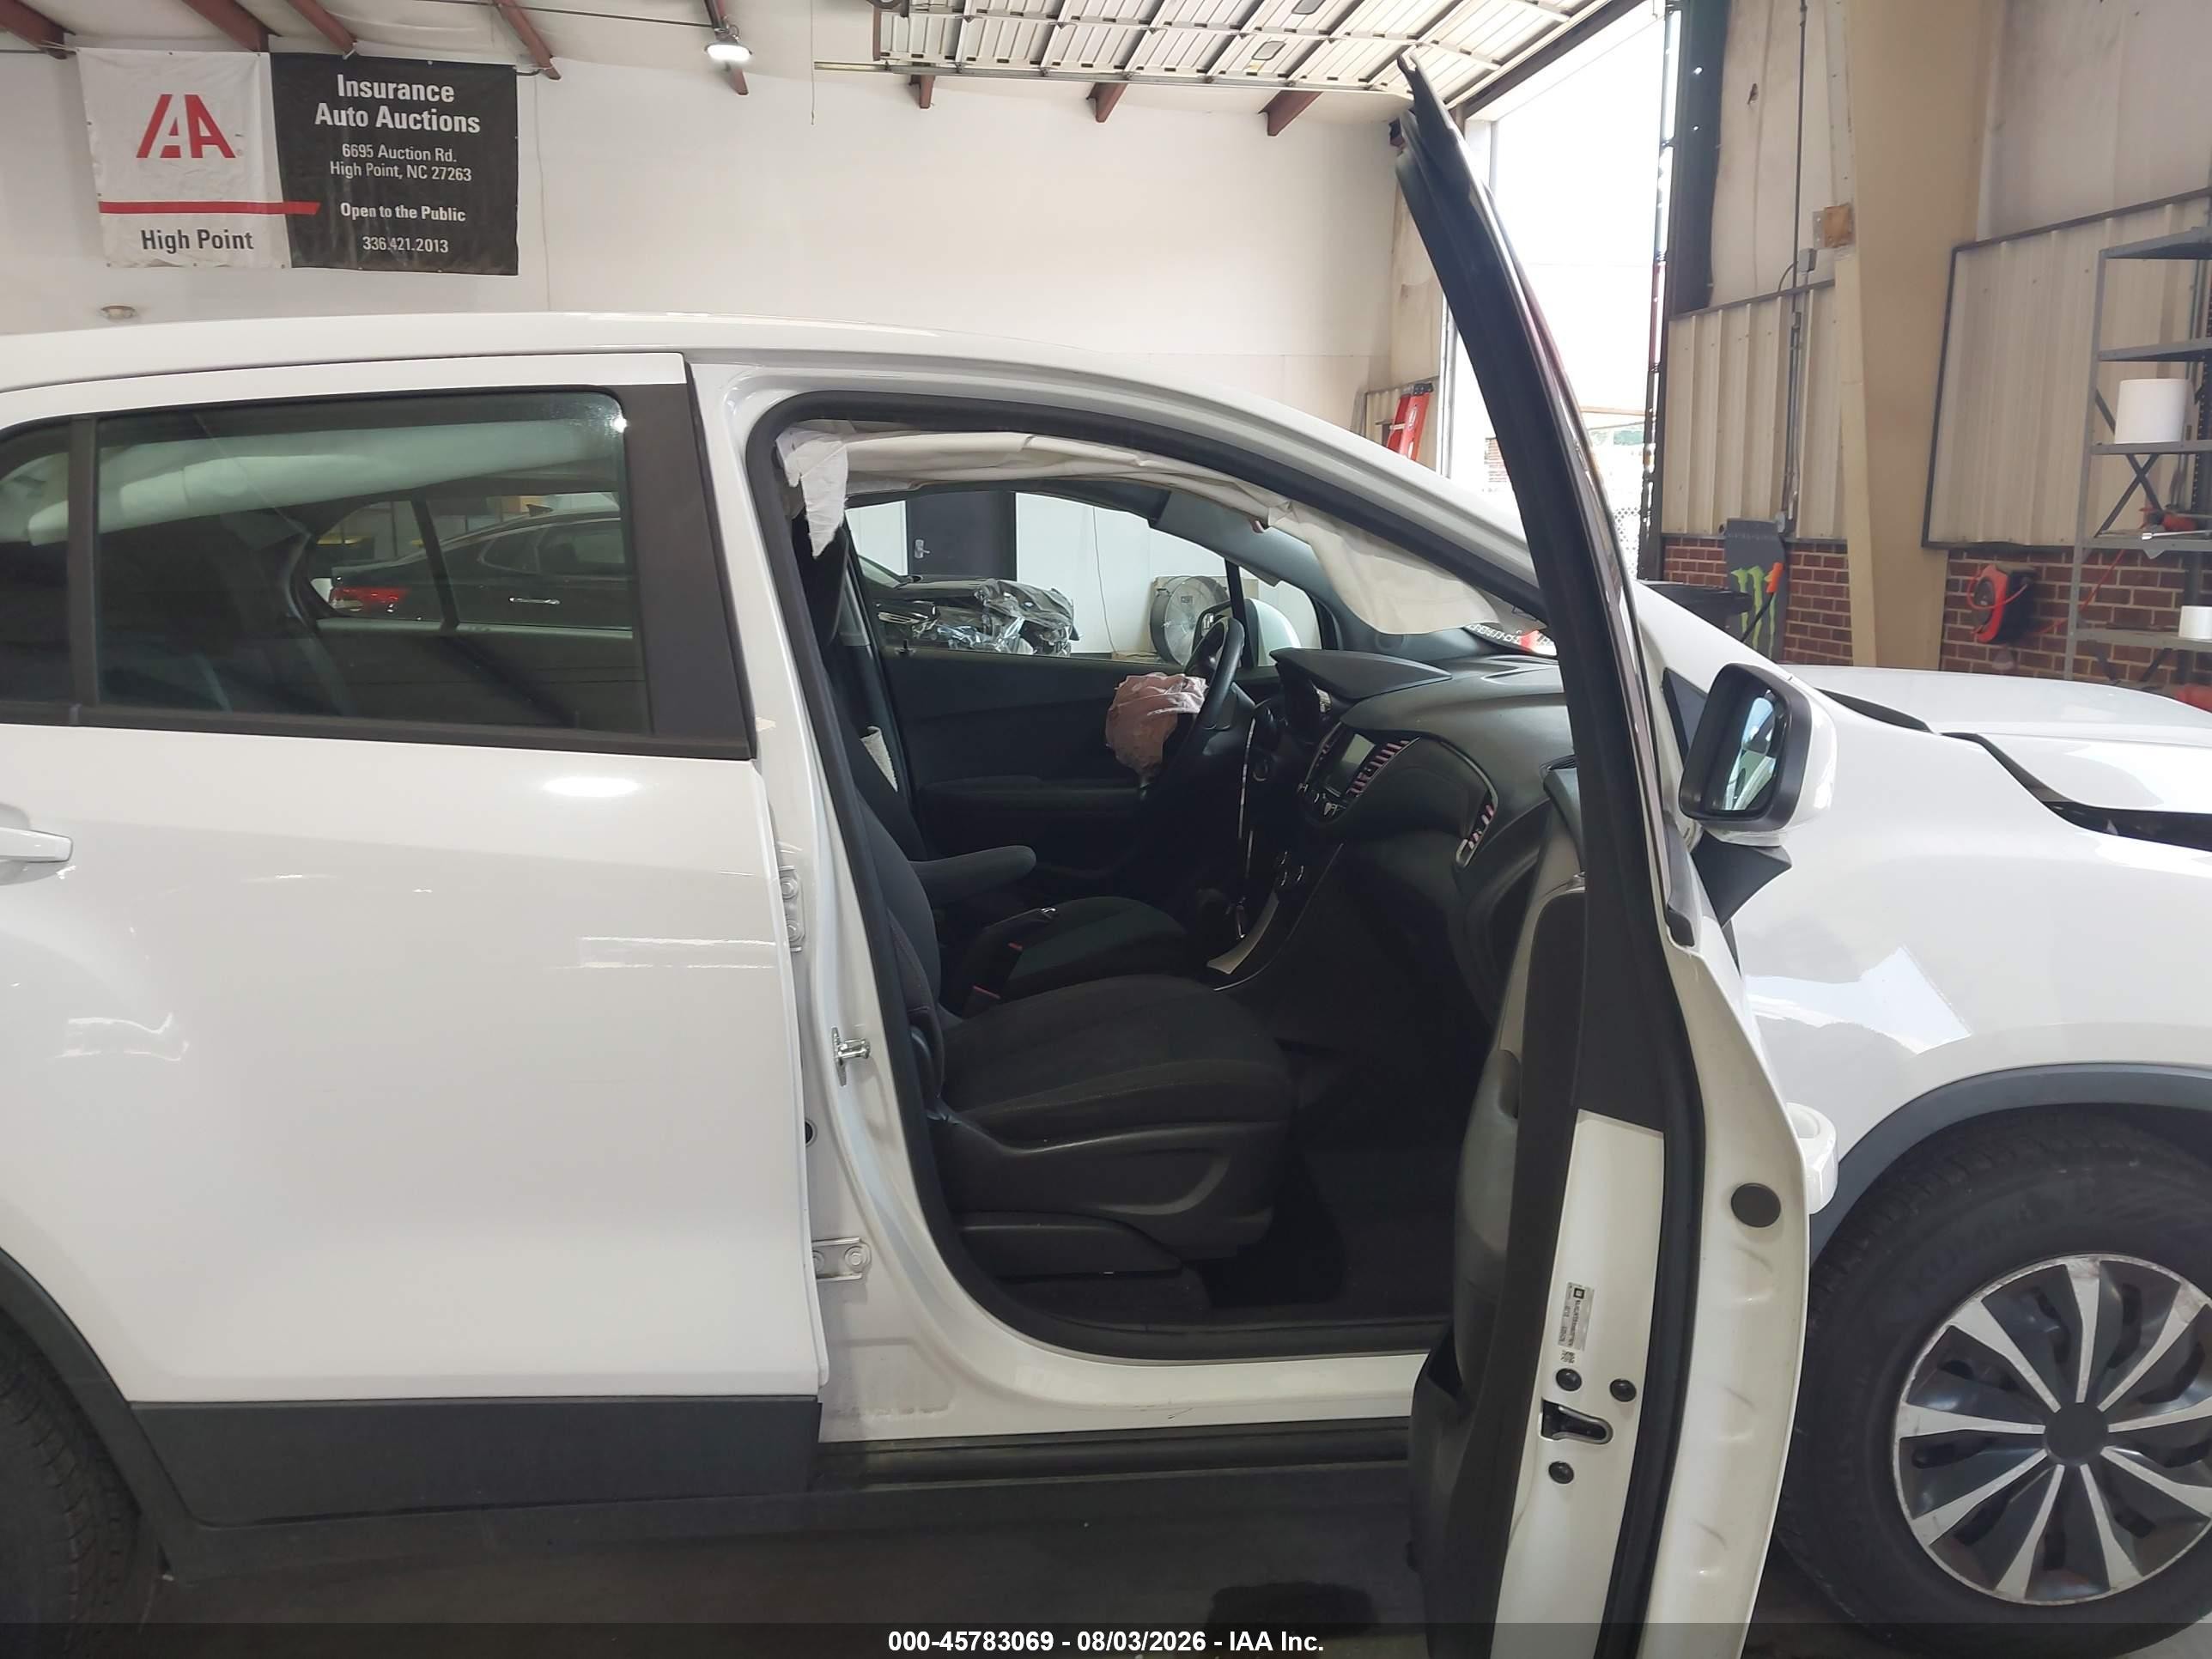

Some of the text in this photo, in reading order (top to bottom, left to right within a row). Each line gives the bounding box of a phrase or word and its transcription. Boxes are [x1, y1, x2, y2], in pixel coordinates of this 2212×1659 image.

[337, 74, 454, 102] Insurance
[314, 102, 481, 133] Auto Auctions
[342, 143, 457, 162] 6695 Auction Rd.
[330, 161, 471, 181] High Point, NC 27263
[340, 203, 466, 222] Open to the Public
[141, 228, 254, 254] High Point
[362, 236, 449, 252] 336.421.2013
